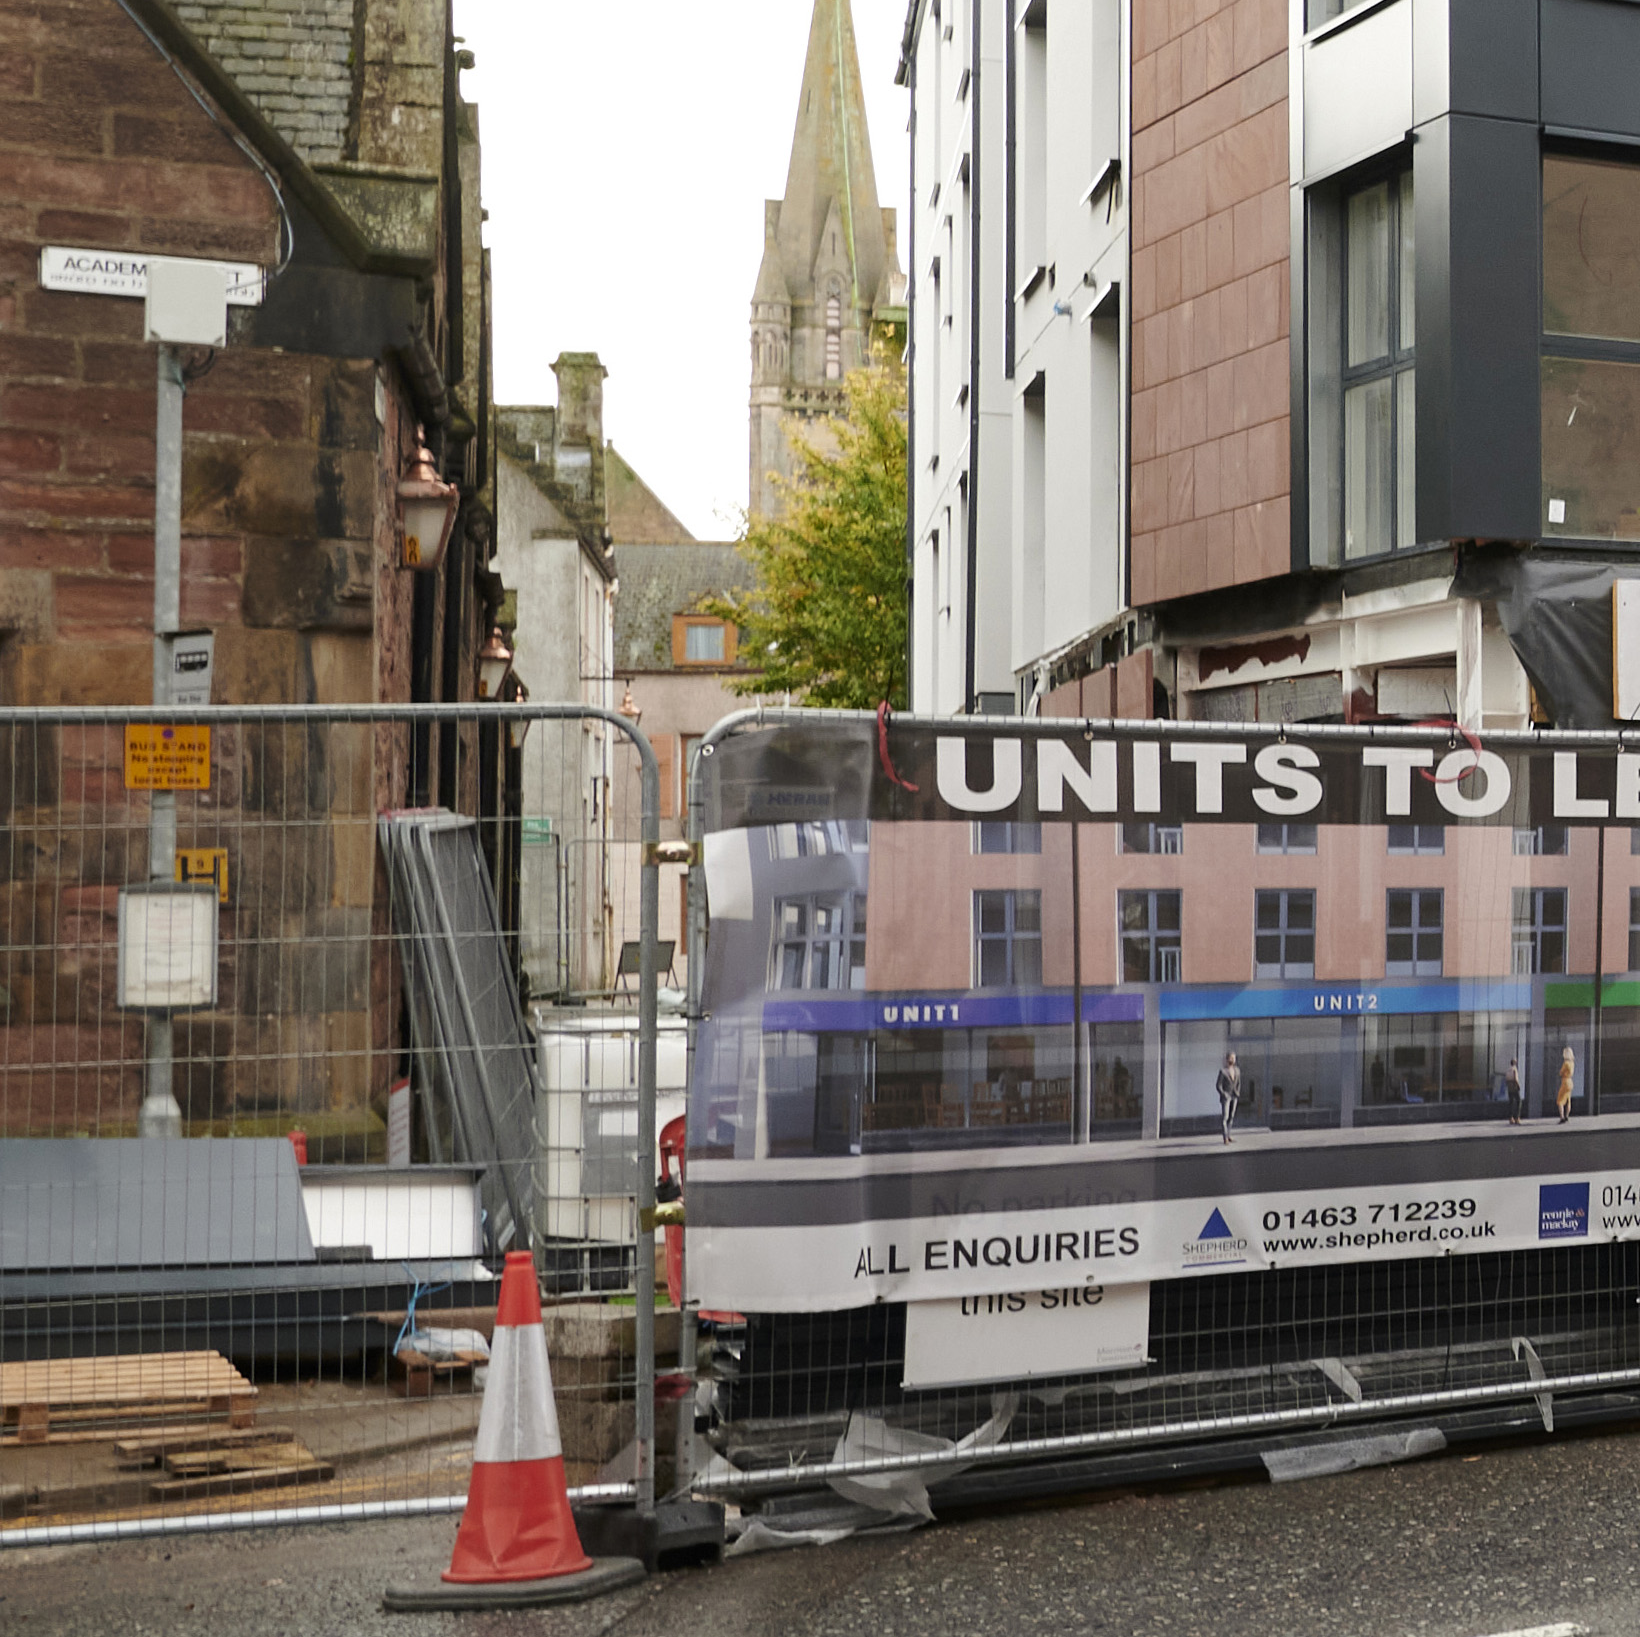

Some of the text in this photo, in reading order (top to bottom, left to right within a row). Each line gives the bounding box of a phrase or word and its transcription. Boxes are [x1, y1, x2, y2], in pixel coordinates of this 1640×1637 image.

[64, 255, 149, 276] ACADEM
[935, 735, 1324, 815] UNITS
[1363, 747, 1511, 818] TO
[1262, 1198, 1478, 1232] 01463 712239
[854, 1226, 1141, 1279] ALL ENQUIRIES
[1182, 1237, 1248, 1254] SHEPHERD
[1263, 1221, 1496, 1253] www.shepherd.co.uk
[1040, 1283, 1105, 1310] site
